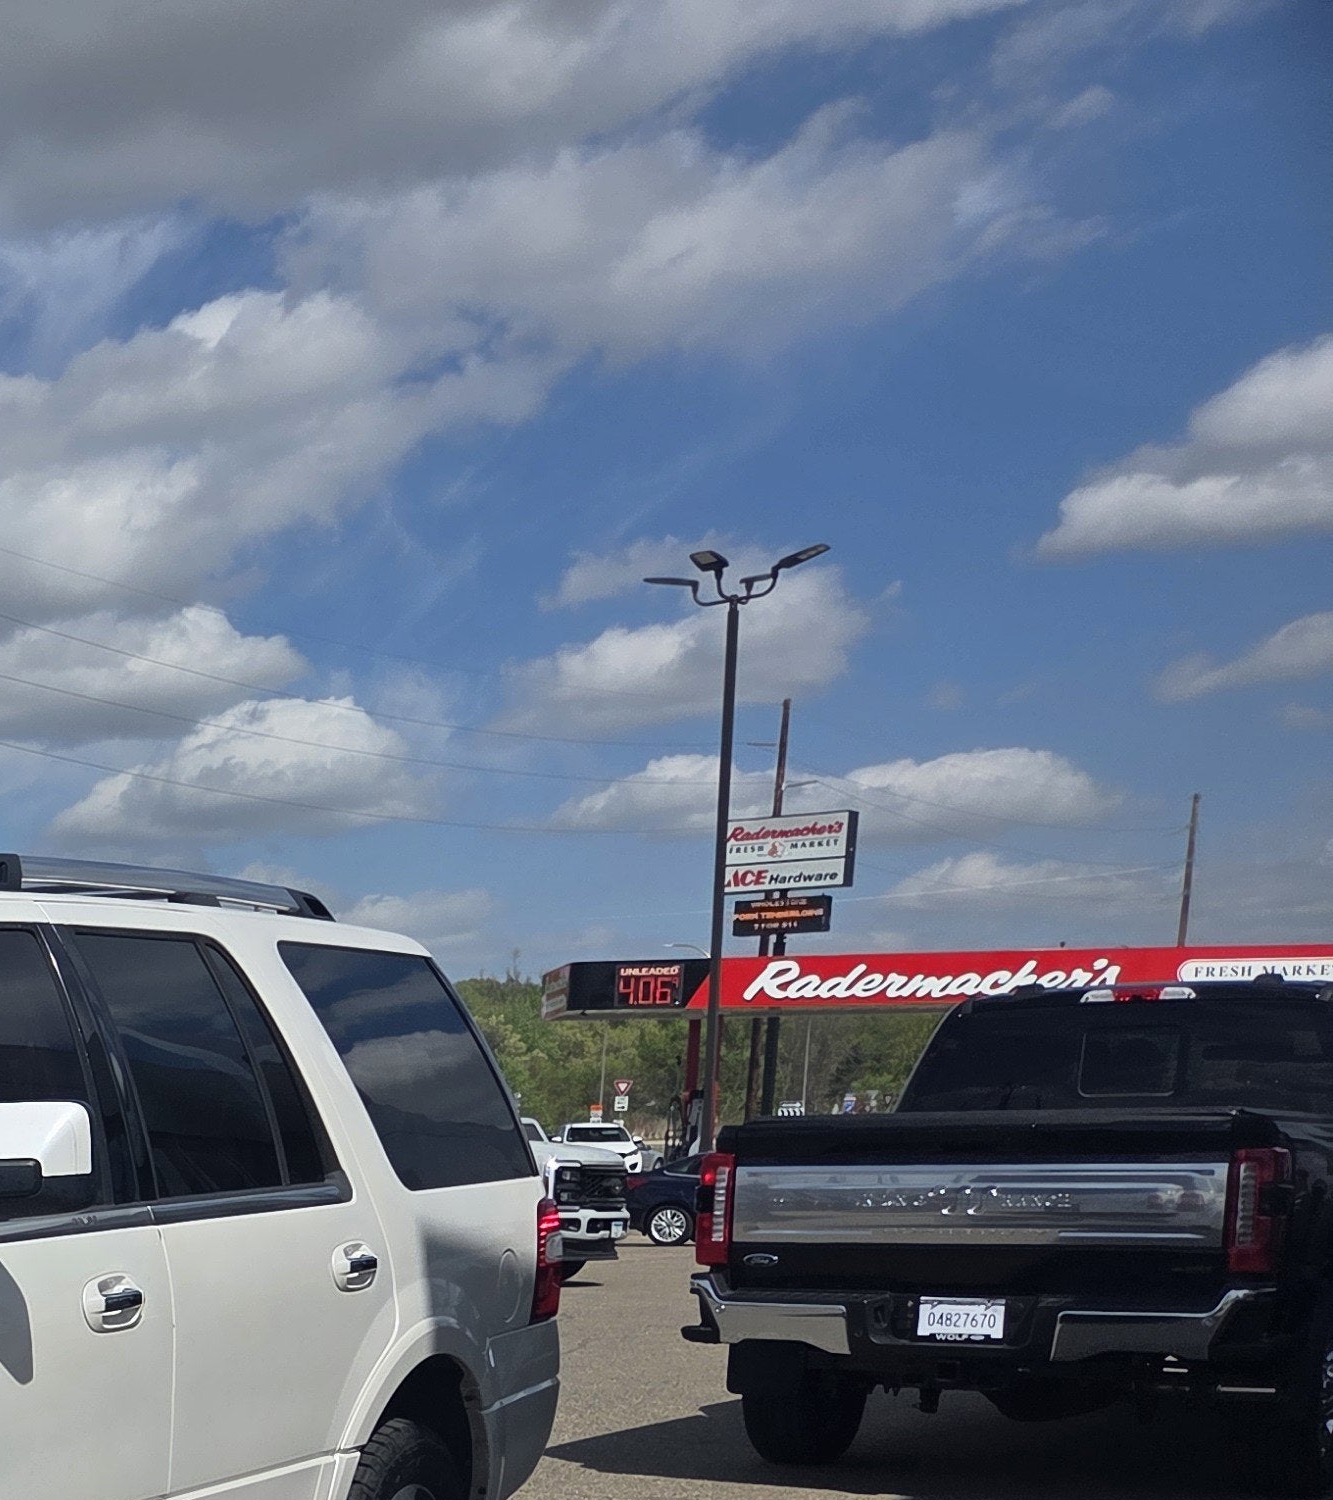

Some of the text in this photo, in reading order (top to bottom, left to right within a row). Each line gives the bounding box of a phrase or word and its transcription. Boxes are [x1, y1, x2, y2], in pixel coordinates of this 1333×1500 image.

[726, 820, 844, 843] Radermacher's
[729, 838, 839, 854] FRESH MARKET
[724, 869, 839, 888] ACE Hardware
[620, 965, 681, 976] UNLEADED
[1194, 965, 1253, 977] FRESH
[743, 958, 1121, 1001] Radermacher's
[928, 1312, 996, 1329] 04827670
